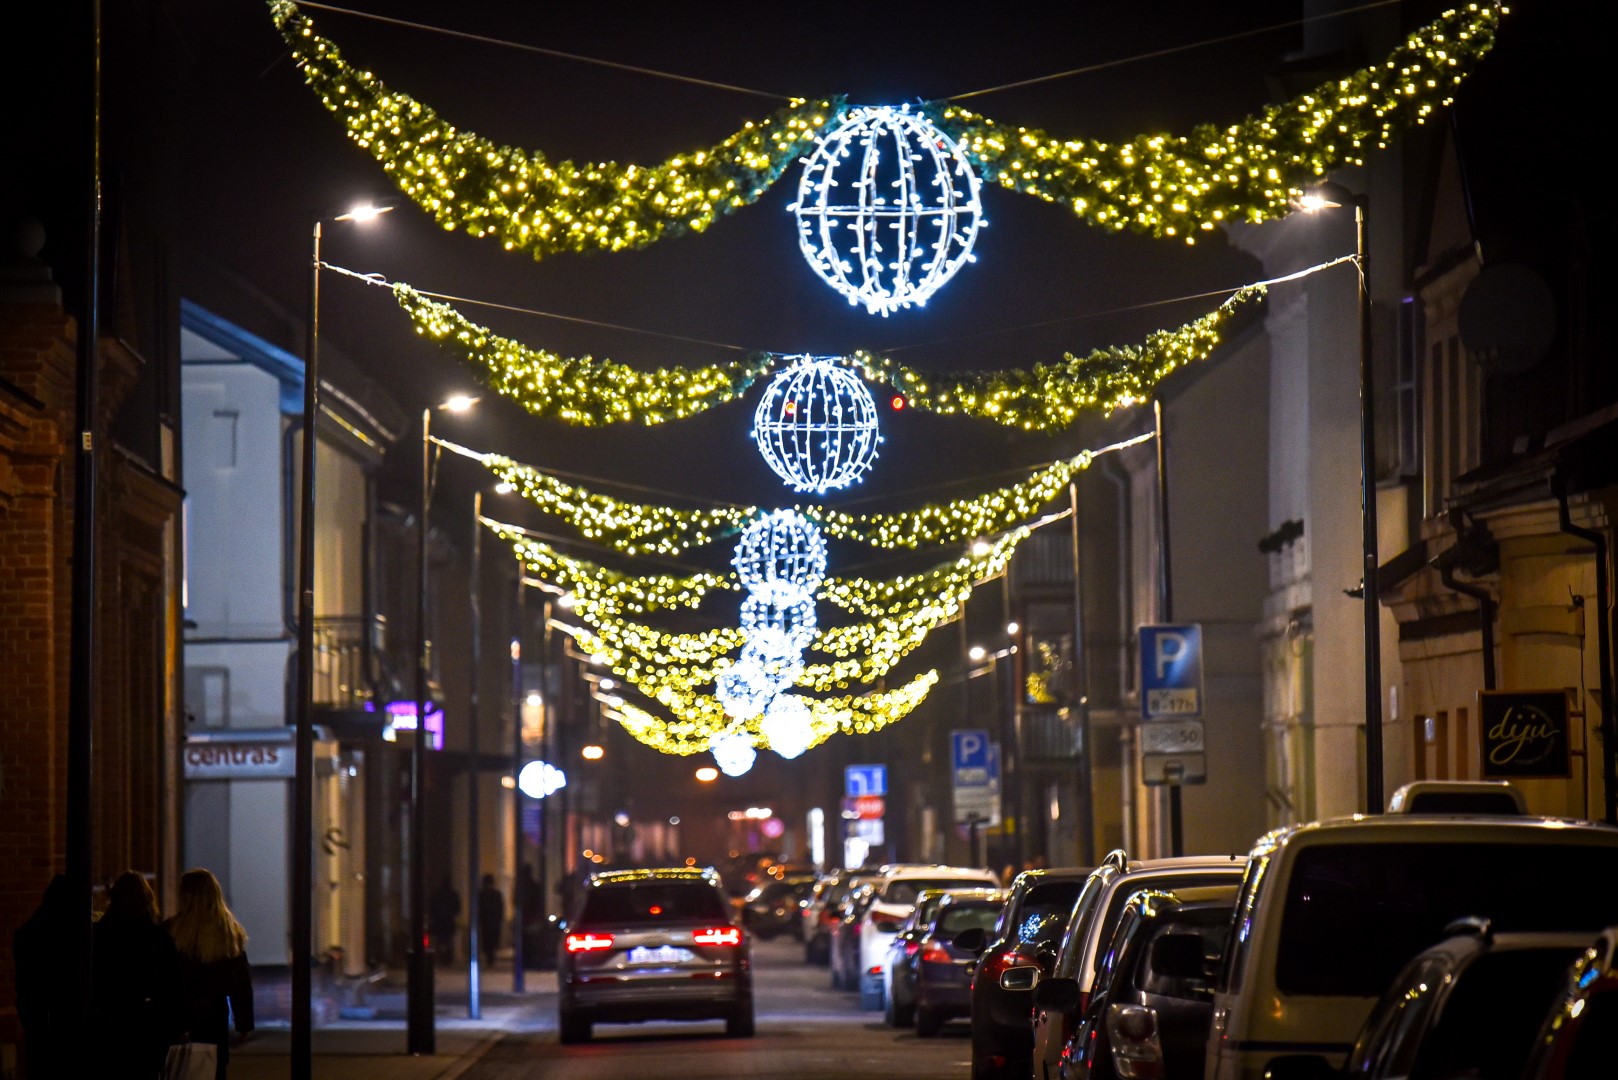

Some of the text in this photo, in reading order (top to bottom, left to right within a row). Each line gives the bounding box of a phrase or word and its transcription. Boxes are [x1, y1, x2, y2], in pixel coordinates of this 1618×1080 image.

[1155, 632, 1188, 679] P
[961, 735, 981, 763] P
[1488, 706, 1560, 765] diju
[187, 743, 279, 766] centras
